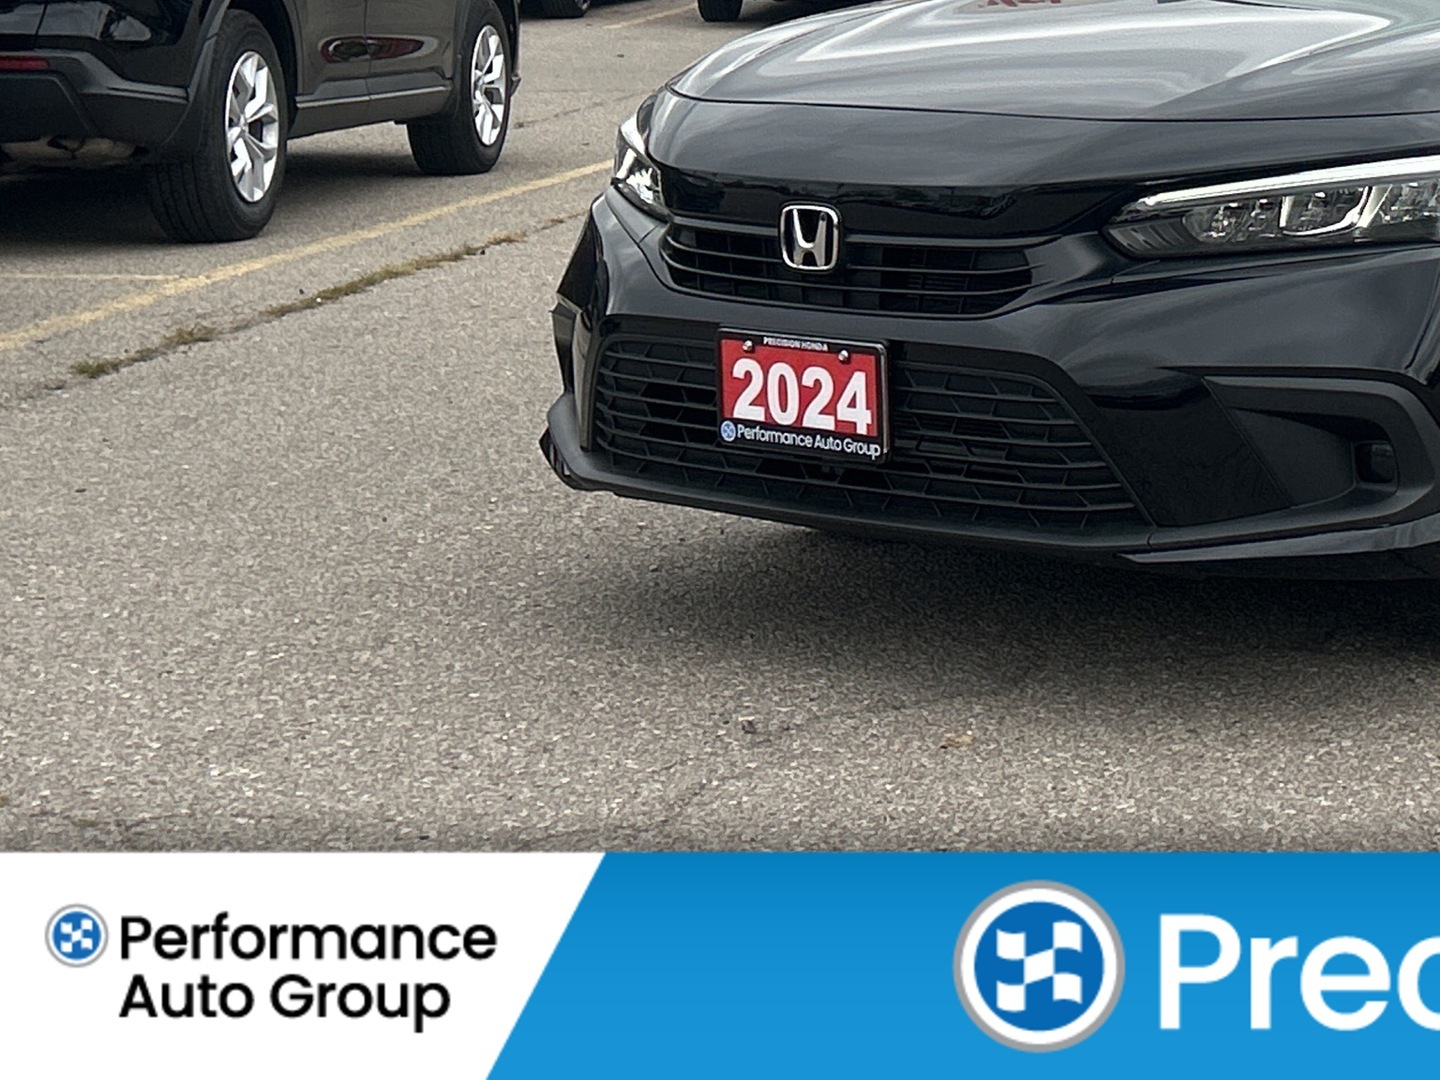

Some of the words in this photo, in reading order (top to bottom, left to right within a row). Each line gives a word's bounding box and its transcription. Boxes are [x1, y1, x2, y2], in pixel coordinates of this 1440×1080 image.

[801, 341, 829, 352] HONDA
[732, 357, 872, 436] 2024
[737, 424, 813, 448] Performance
[814, 434, 842, 452] Auto
[843, 438, 881, 460] Group
